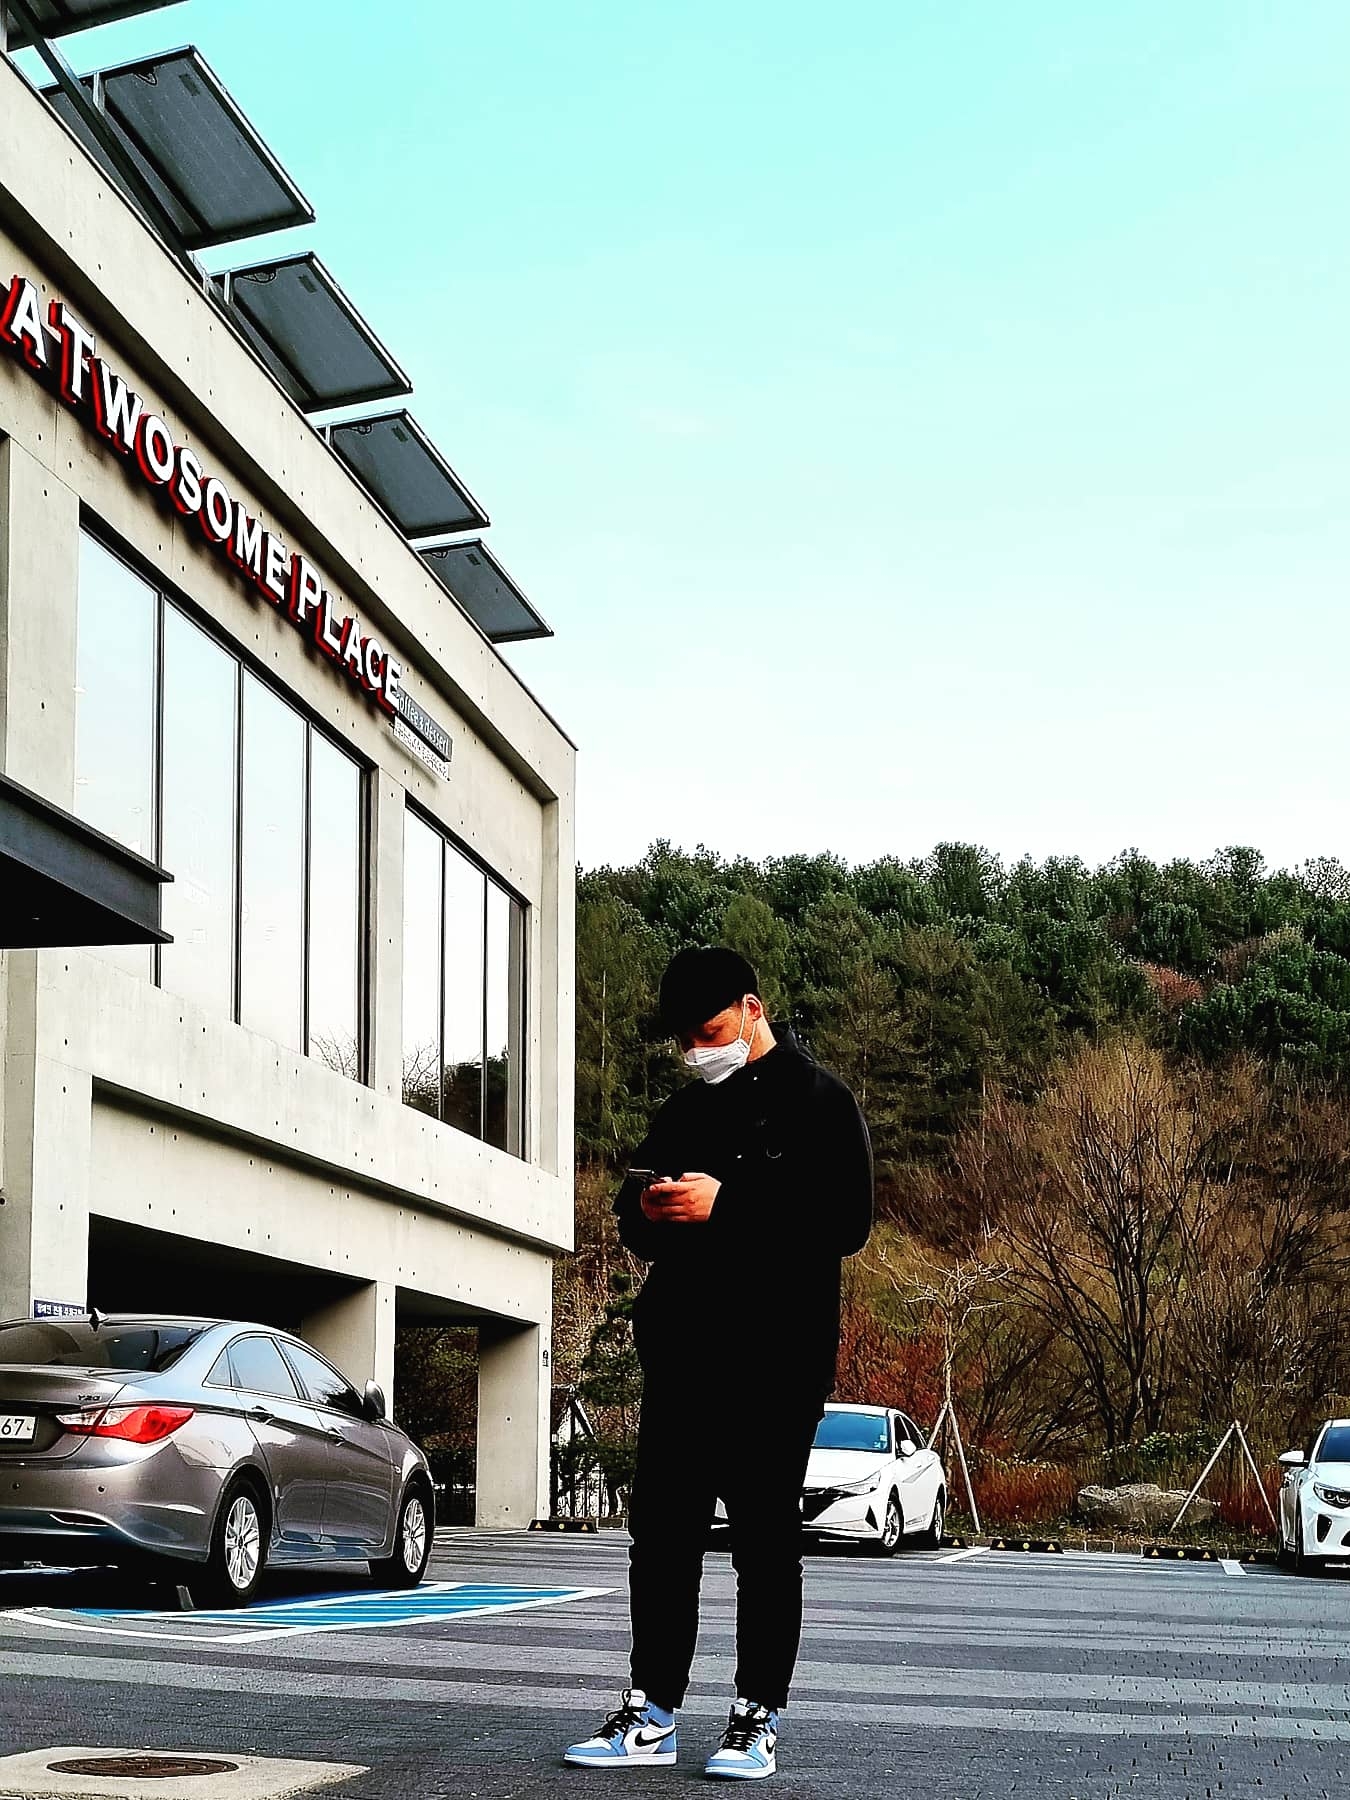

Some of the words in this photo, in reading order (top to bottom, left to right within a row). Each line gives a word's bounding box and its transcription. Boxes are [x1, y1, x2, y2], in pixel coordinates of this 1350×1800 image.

[9, 278, 47, 365] A
[61, 303, 285, 599] TWOSOME
[297, 555, 402, 707] PLACE
[1, 1418, 25, 1436] 67
